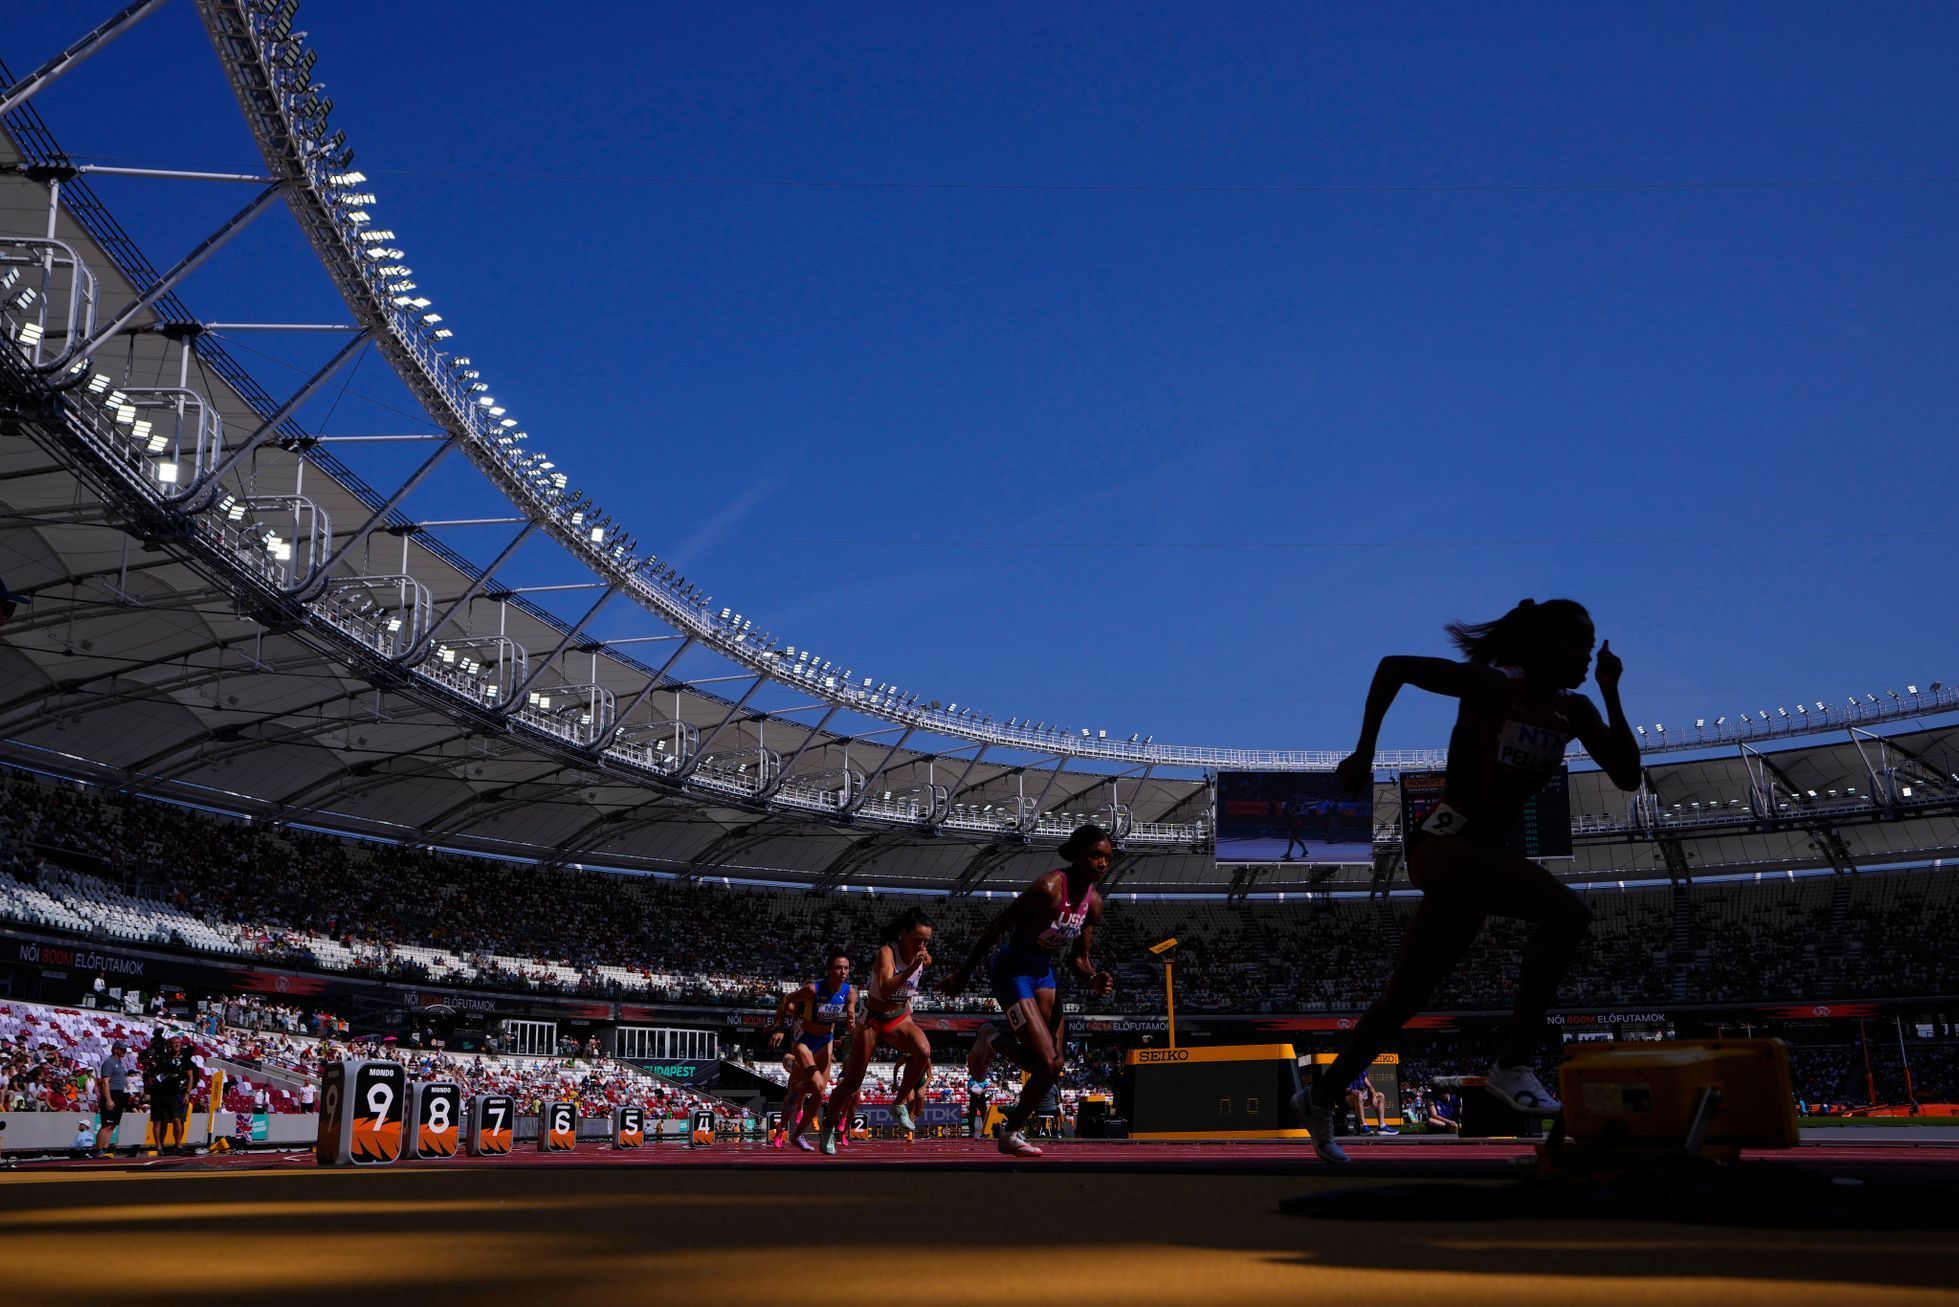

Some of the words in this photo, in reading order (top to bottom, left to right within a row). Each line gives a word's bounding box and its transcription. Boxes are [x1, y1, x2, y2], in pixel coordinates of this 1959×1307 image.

[1432, 812, 1453, 829] 9
[20, 943, 40, 961] NŐI
[41, 947, 73, 967] 800M
[75, 952, 145, 975] ELŐFUTAMOK
[404, 991, 419, 1005] NŐI
[443, 995, 496, 1011] ELŐFUTAMOK
[726, 1012, 741, 1025] NŐI
[1008, 1010, 1019, 1027] 8
[1069, 1020, 1084, 1031] NŐI
[1086, 1020, 1111, 1031] 800M
[1547, 1013, 1565, 1025] NŐI
[1567, 1015, 1595, 1025] 800M
[1597, 1012, 1665, 1024] ELŐFUTAMOK
[1140, 1050, 1188, 1062] SEIKO
[1374, 1055, 1396, 1063] EIKO
[369, 1068, 394, 1077] MONDO
[431, 1086, 452, 1094] MONDO
[326, 1084, 338, 1133] 9
[366, 1082, 394, 1132] 9
[428, 1096, 450, 1134] 8
[922, 1107, 960, 1121] TDK
[488, 1107, 506, 1137] 7
[555, 1110, 570, 1135] 6
[625, 1115, 638, 1136] 5
[698, 1117, 710, 1135] 4
[854, 1118, 864, 1133] 2
